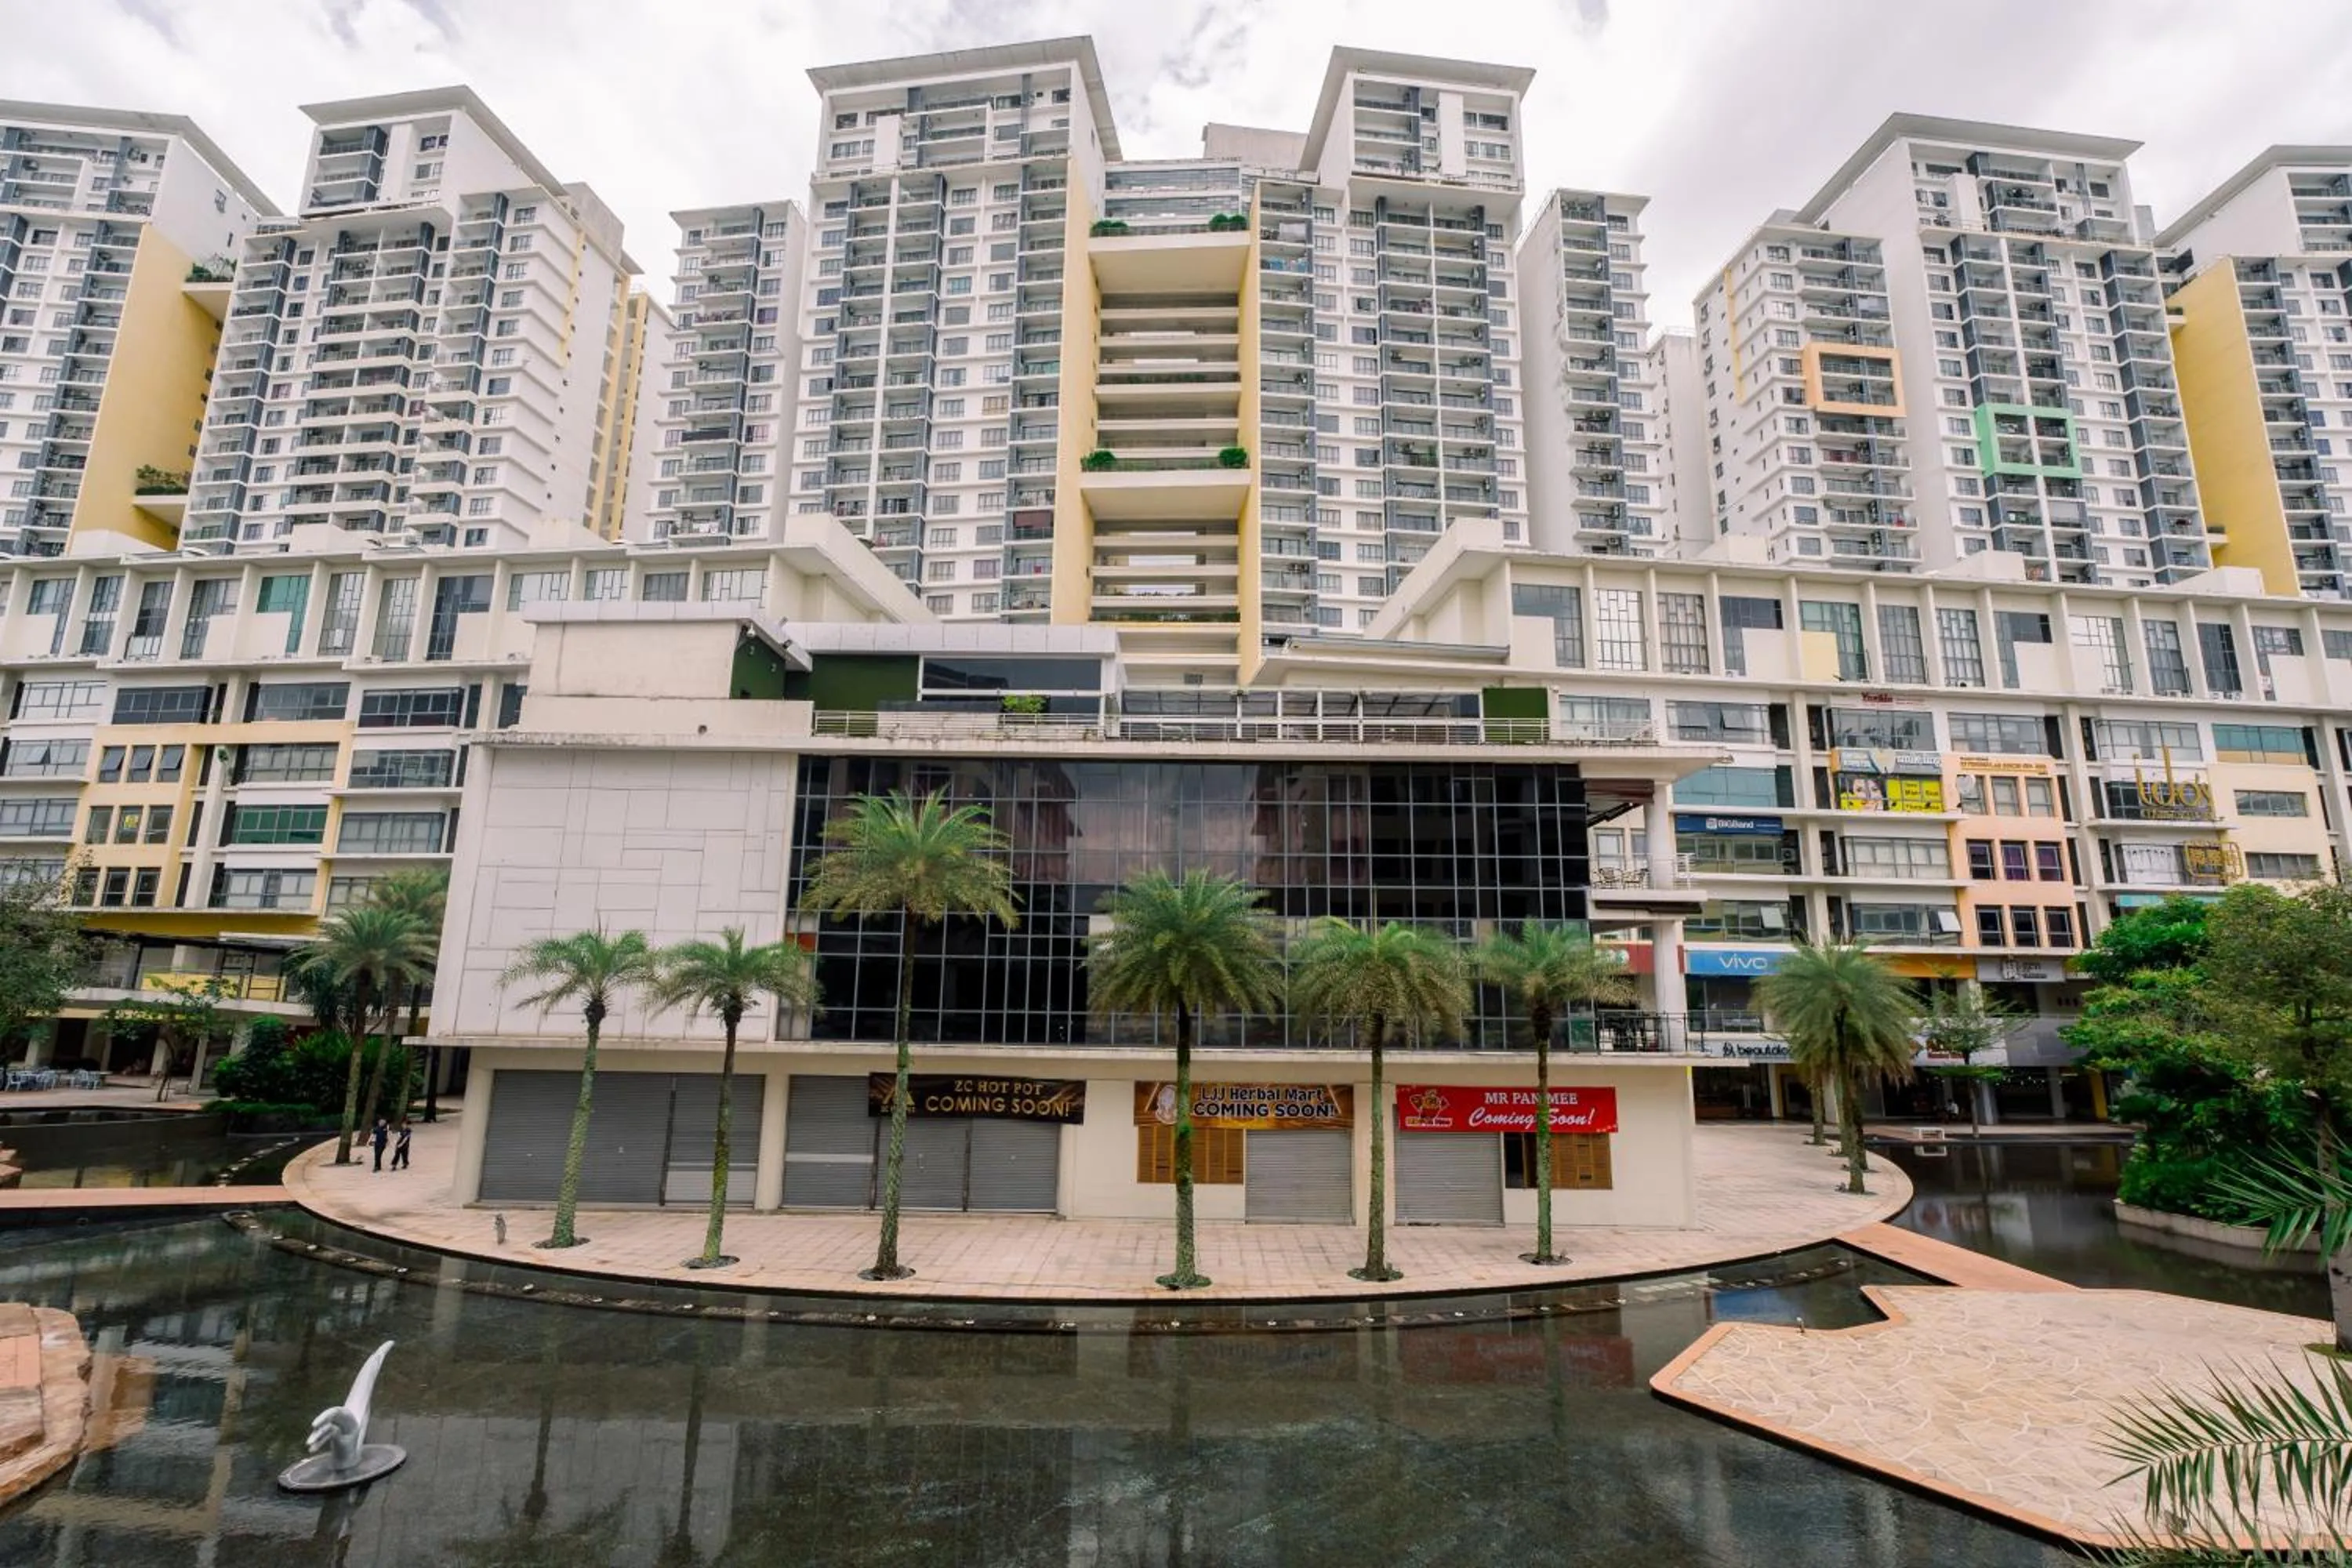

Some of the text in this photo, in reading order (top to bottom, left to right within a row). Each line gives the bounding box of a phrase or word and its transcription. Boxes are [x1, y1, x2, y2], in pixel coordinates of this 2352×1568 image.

[1719, 953, 1768, 970] vivo
[954, 1080, 1044, 1095] ZC HOT POT
[1229, 1087, 1281, 1102] Herbal
[1285, 1089, 1323, 1102] Mart
[1484, 1092, 1578, 1105] MR PAN MEE
[925, 1096, 1006, 1112] COMING
[1011, 1098, 1070, 1117] SOON!
[1193, 1102, 1334, 1117] COMING SOON!
[1468, 1107, 1537, 1130] Coming
[1548, 1108, 1595, 1125] Soon!
